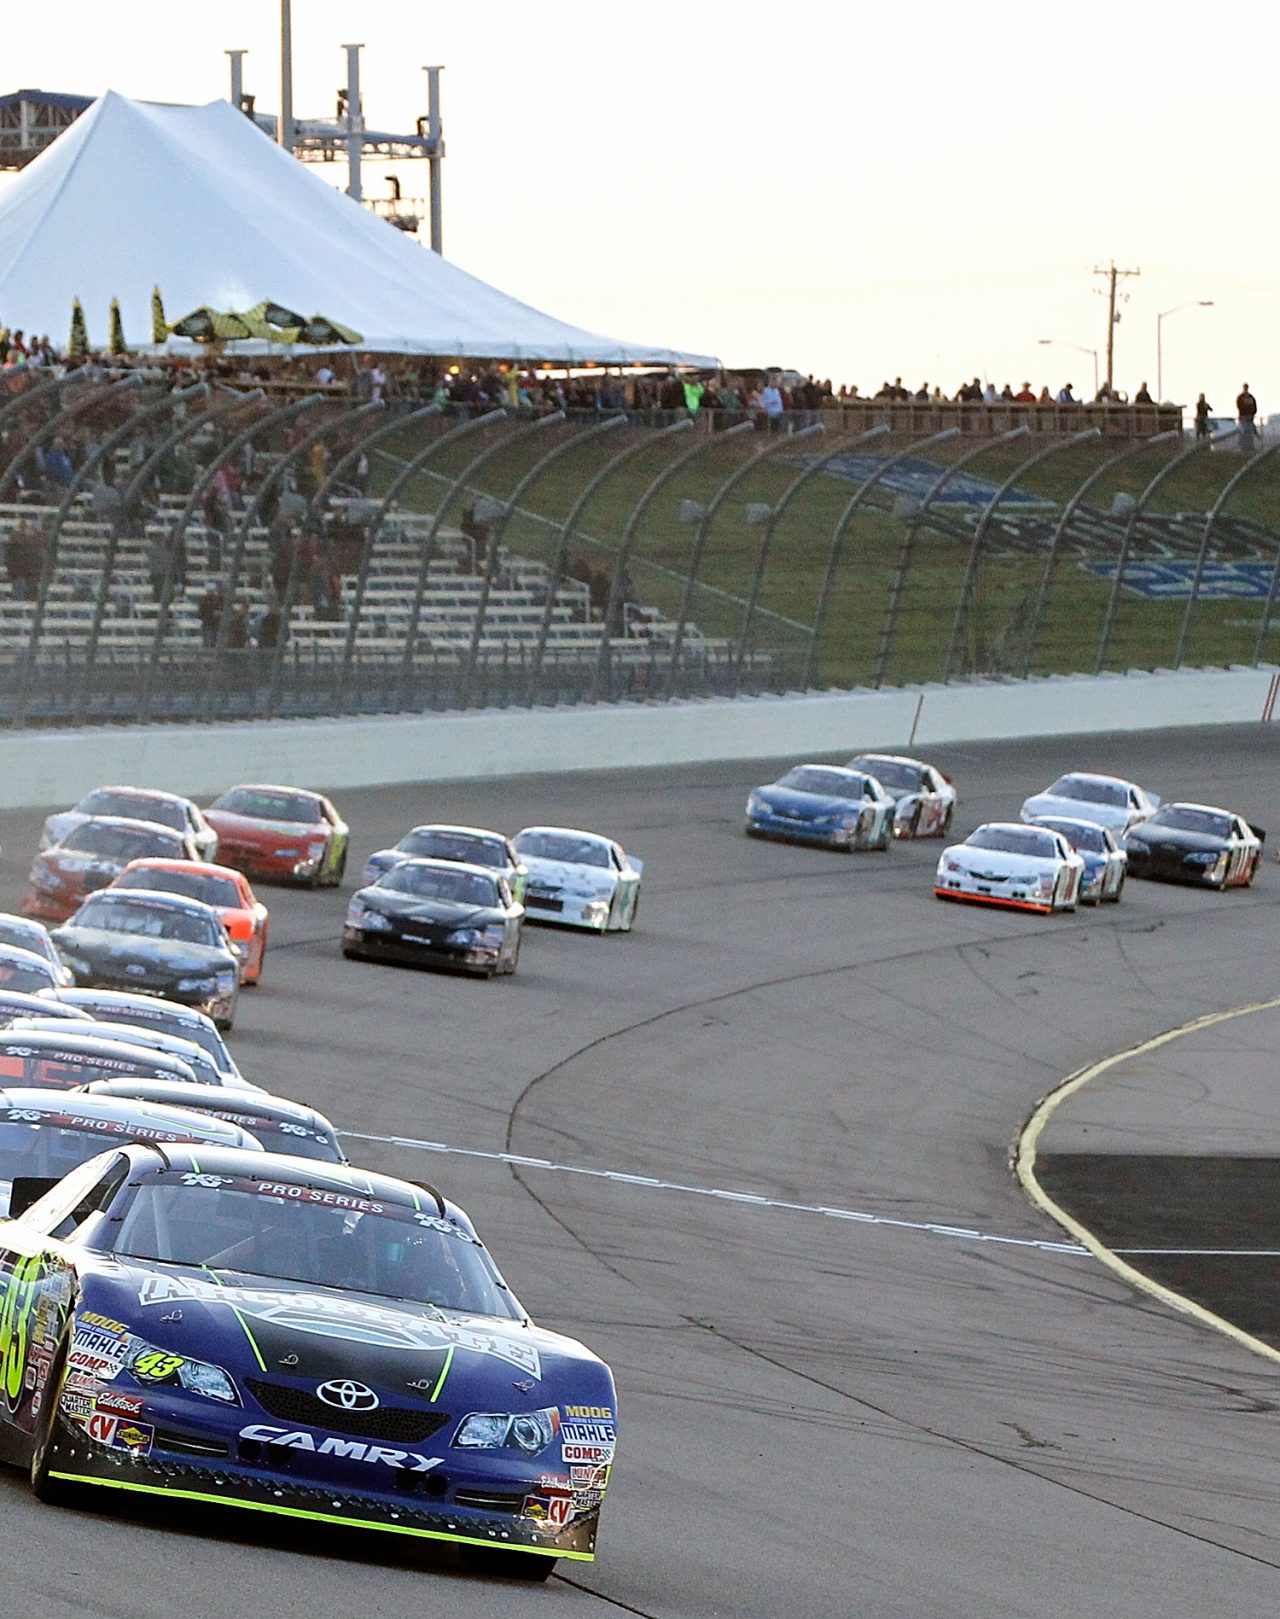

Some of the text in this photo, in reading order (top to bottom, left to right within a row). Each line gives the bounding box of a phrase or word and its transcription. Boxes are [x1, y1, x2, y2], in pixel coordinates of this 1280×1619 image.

[54, 1052, 136, 1072] PRO SERIES
[204, 1109, 257, 1125] SERIES
[71, 1116, 178, 1143] PRO SERIES
[258, 1181, 384, 1214] PRO SERIES
[78, 1310, 131, 1334] MOOG
[74, 1329, 129, 1359] MAHLE
[69, 1351, 108, 1371] COMP
[134, 1352, 185, 1377] 43
[97, 1391, 141, 1415] Edelbrock
[565, 1405, 612, 1418] MOOG
[89, 1414, 115, 1441] CV
[116, 1430, 150, 1444] SUNOCO
[561, 1424, 615, 1441] MAHLE
[239, 1425, 445, 1473] CAMRY
[565, 1446, 601, 1460] COMP
[550, 1500, 571, 1523] CV
